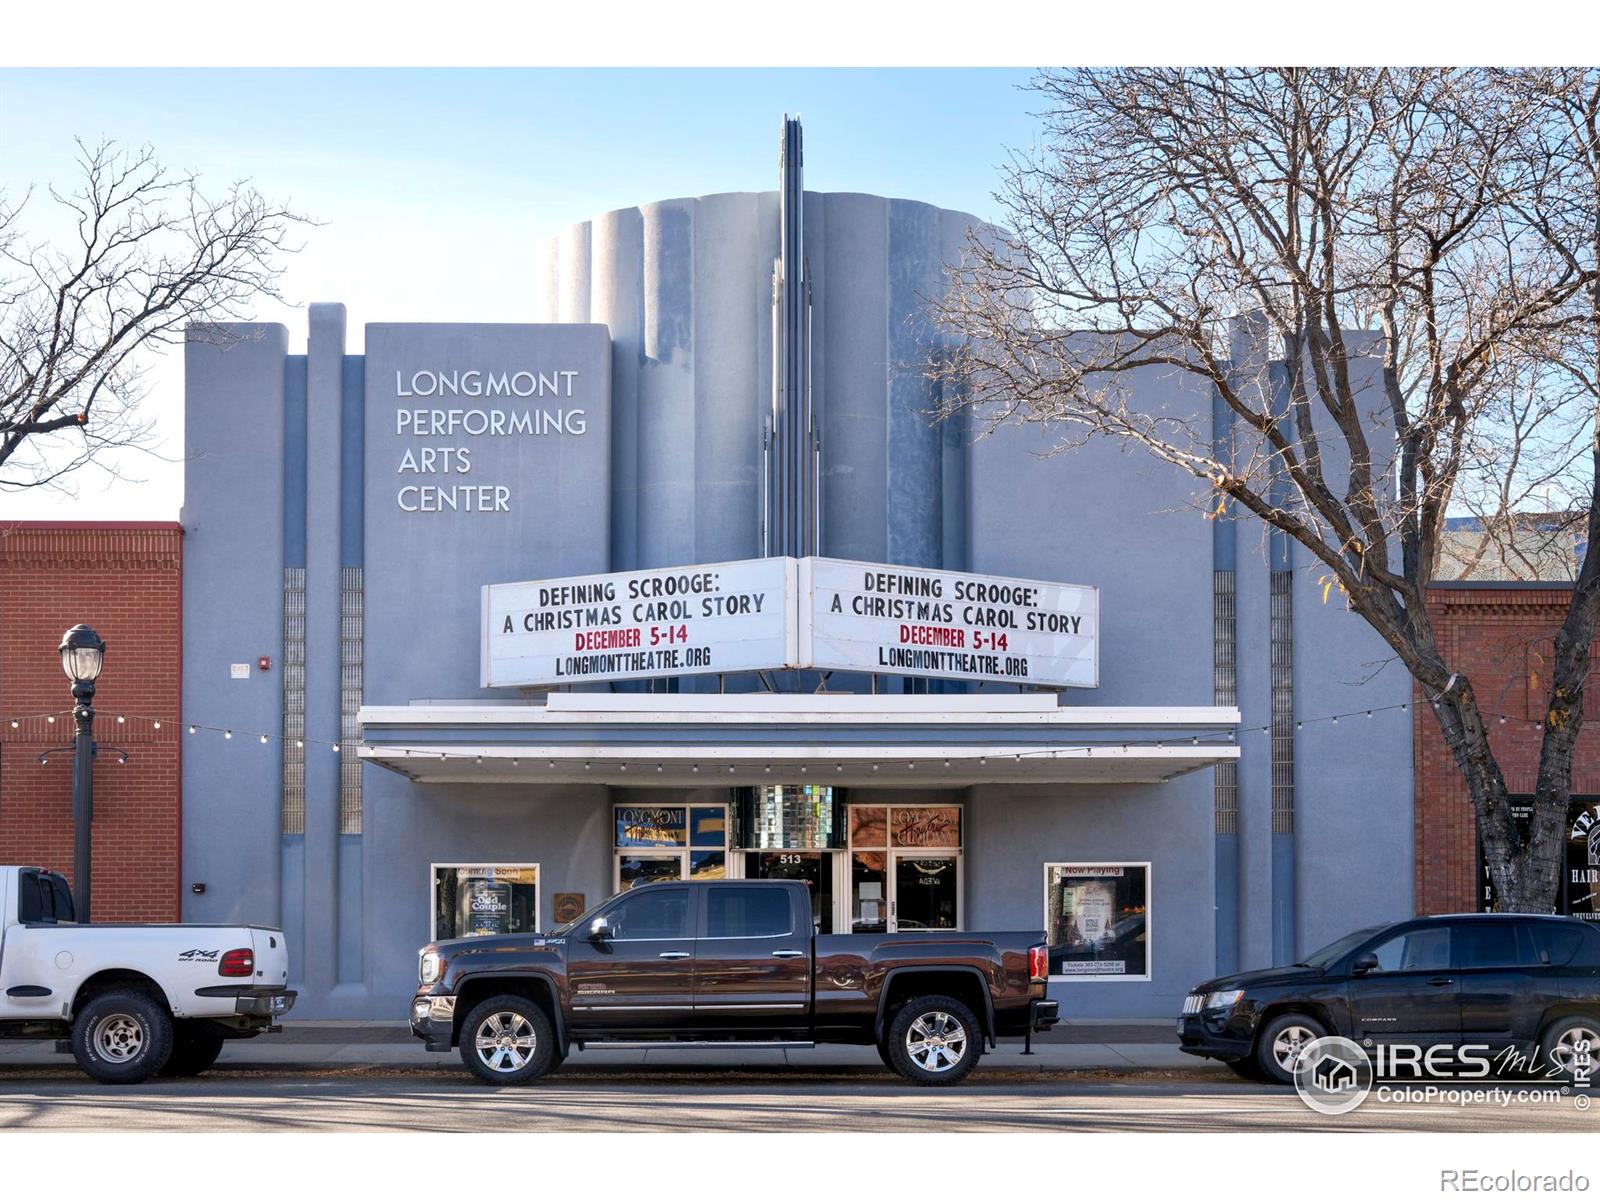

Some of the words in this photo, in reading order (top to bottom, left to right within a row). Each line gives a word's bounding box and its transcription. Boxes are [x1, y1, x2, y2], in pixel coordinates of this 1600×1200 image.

[396, 370, 578, 397] LONGMONT
[396, 409, 586, 436] PERFORMING
[397, 448, 471, 473] ARTS
[397, 486, 511, 512] CENTER
[539, 582, 616, 607] DEFINING
[628, 573, 720, 597] SCROOGE:
[864, 572, 943, 598] DEFINING
[954, 580, 1038, 607] SCROOGE:
[503, 615, 514, 634] A
[523, 606, 622, 632] CHRISTMAS
[632, 600, 692, 622] CAROL
[702, 592, 766, 617] STORY
[831, 593, 843, 613] A
[852, 596, 953, 623] CHRISTMAS
[963, 606, 1018, 629] CAROL
[1026, 612, 1082, 634] STORY
[575, 628, 641, 651] DECEMBER
[649, 624, 688, 646] 5-14
[899, 624, 965, 648] DECEMBER
[972, 631, 1008, 652] 5-14
[556, 647, 711, 677] LONGMONTTHEATRE.ORG
[878, 646, 1029, 677] LONGMONTTHEATRE.ORG
[780, 854, 801, 864] 513
[1087, 867, 1120, 875] Playing
[1571, 869, 1599, 883] HAIR
[472, 902, 507, 912] Couple
[477, 896, 498, 904] Odd
